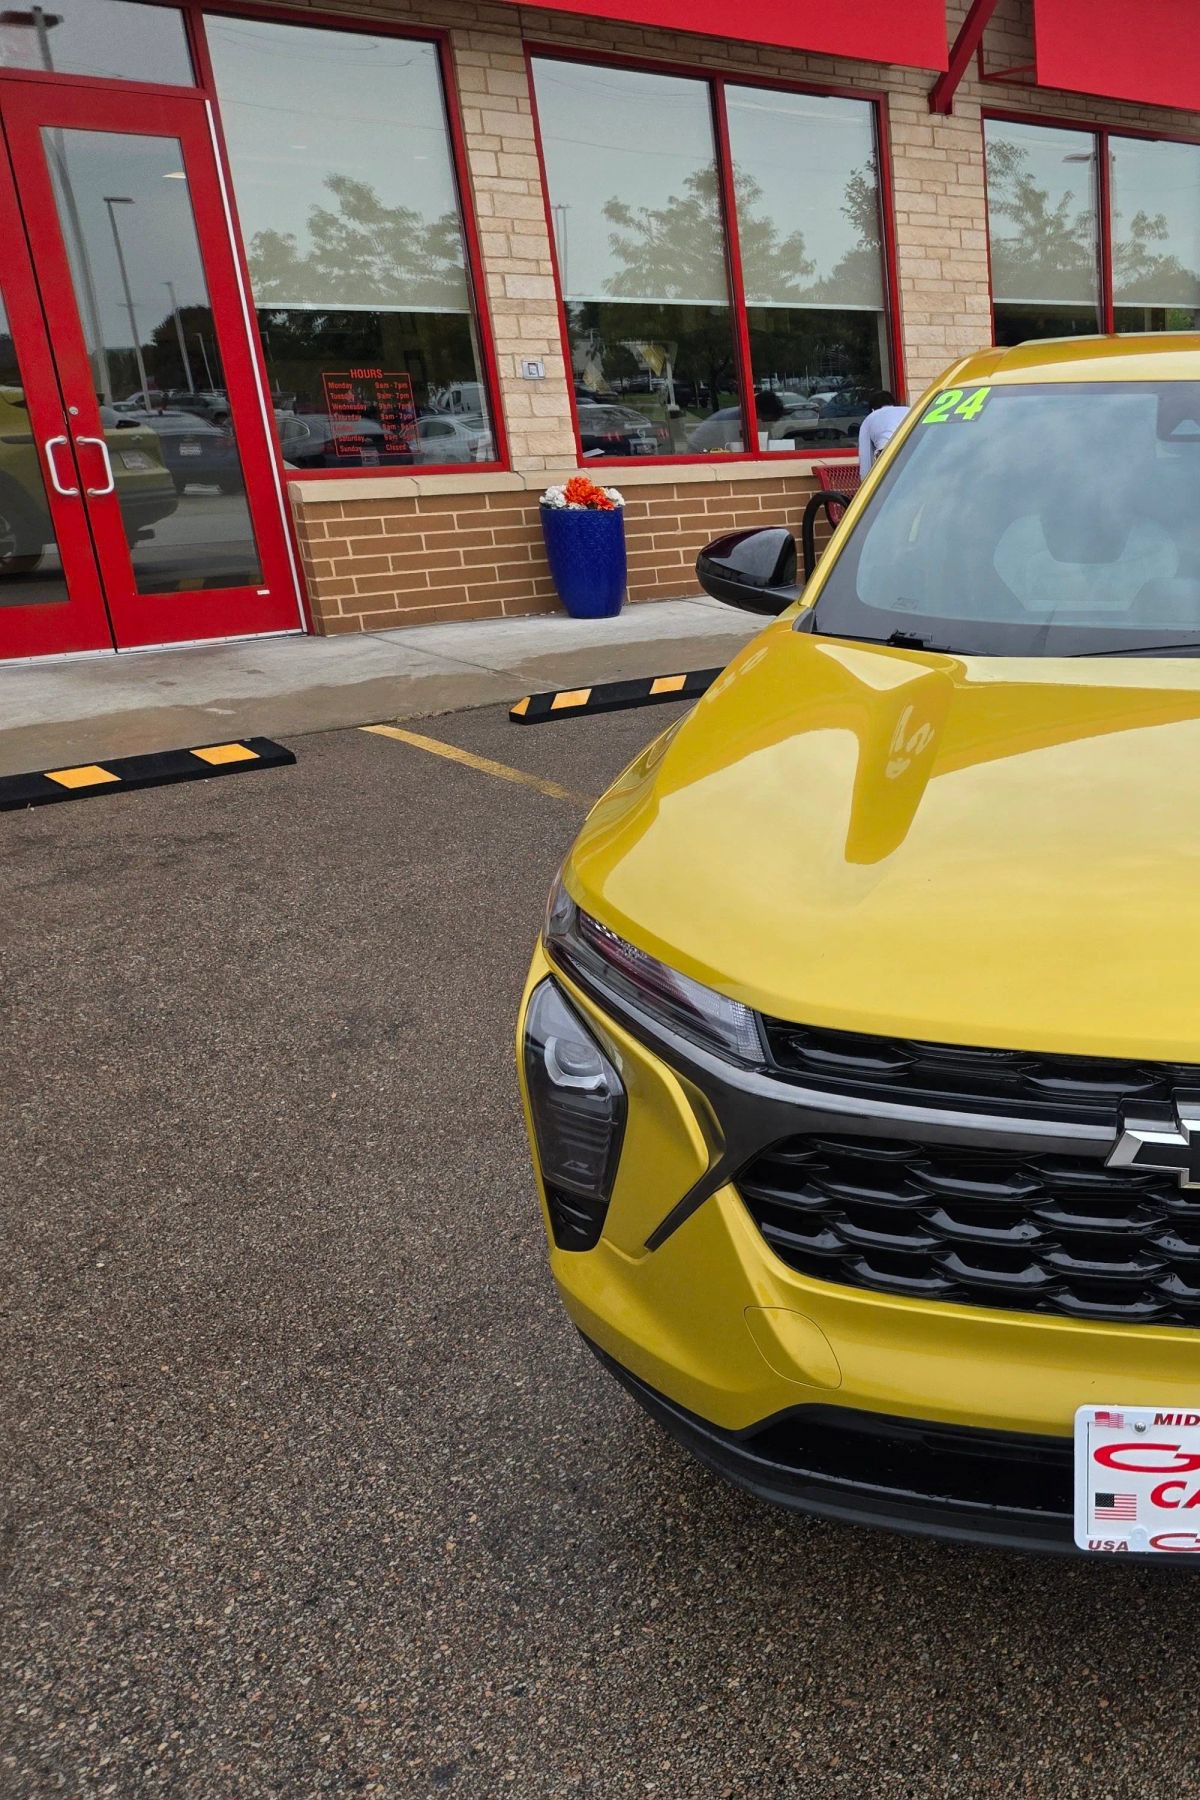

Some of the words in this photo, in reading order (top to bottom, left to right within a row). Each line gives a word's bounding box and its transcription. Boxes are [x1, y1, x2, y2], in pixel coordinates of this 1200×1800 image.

[350, 369, 383, 379] HOURS
[328, 382, 353, 390] Monday
[922, 387, 991, 424] 24
[1087, 1540, 1130, 1552] USA
